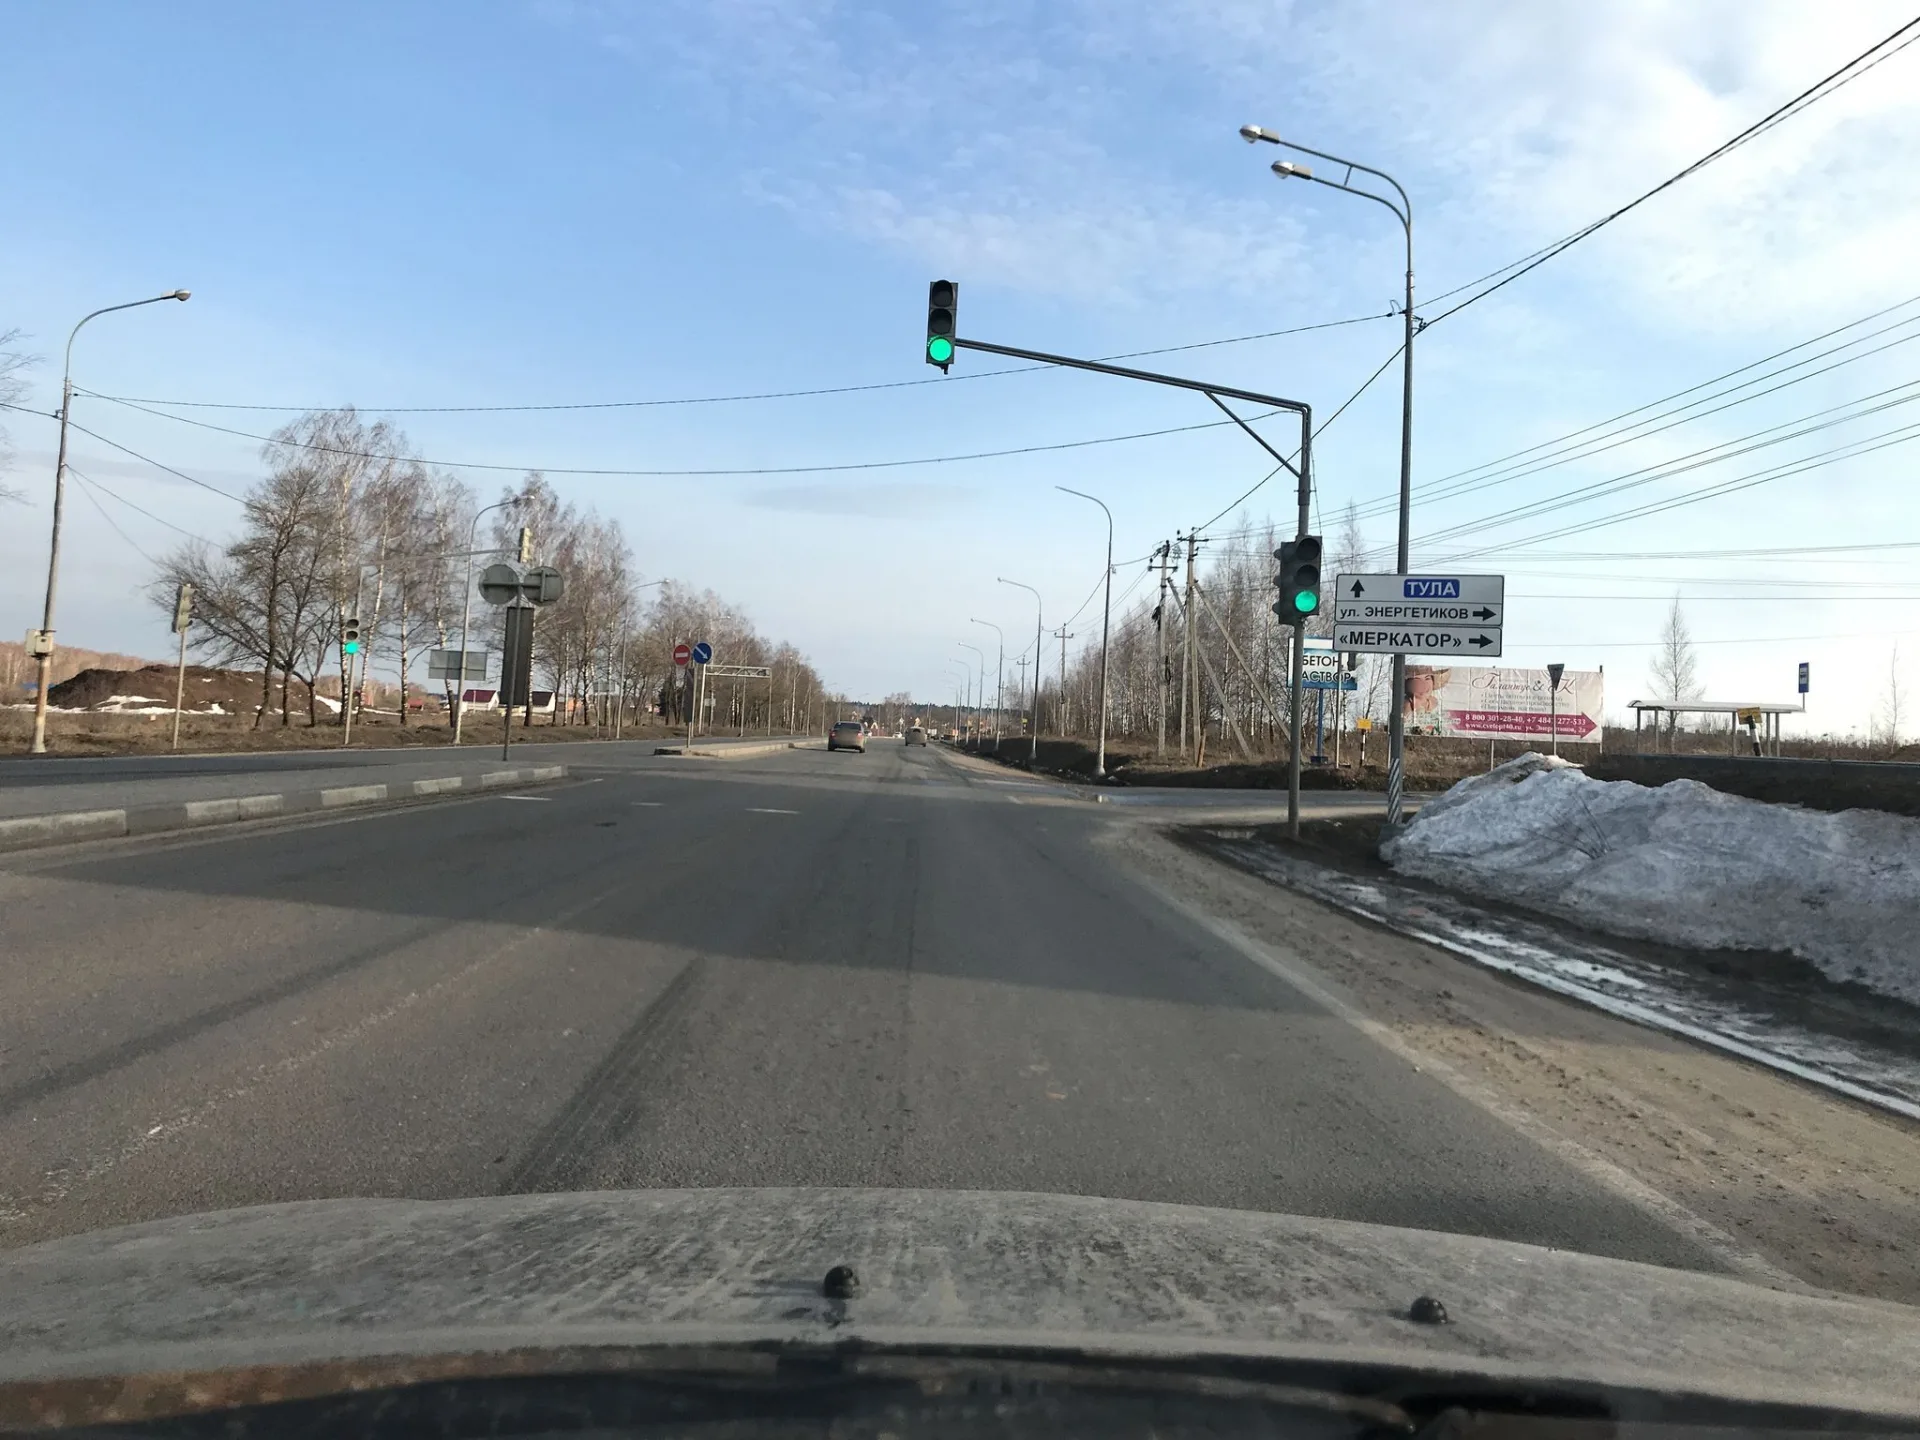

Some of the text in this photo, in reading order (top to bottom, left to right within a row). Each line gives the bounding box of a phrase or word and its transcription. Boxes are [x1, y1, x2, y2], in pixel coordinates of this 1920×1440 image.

[1407, 582, 1456, 597] ТУЛА
[1340, 606, 1469, 619] ул. ЭНЕРГЕТИКОВ
[1339, 631, 1462, 648] «МЕРКАТОР»
[1301, 671, 1352, 683] АСТВОР
